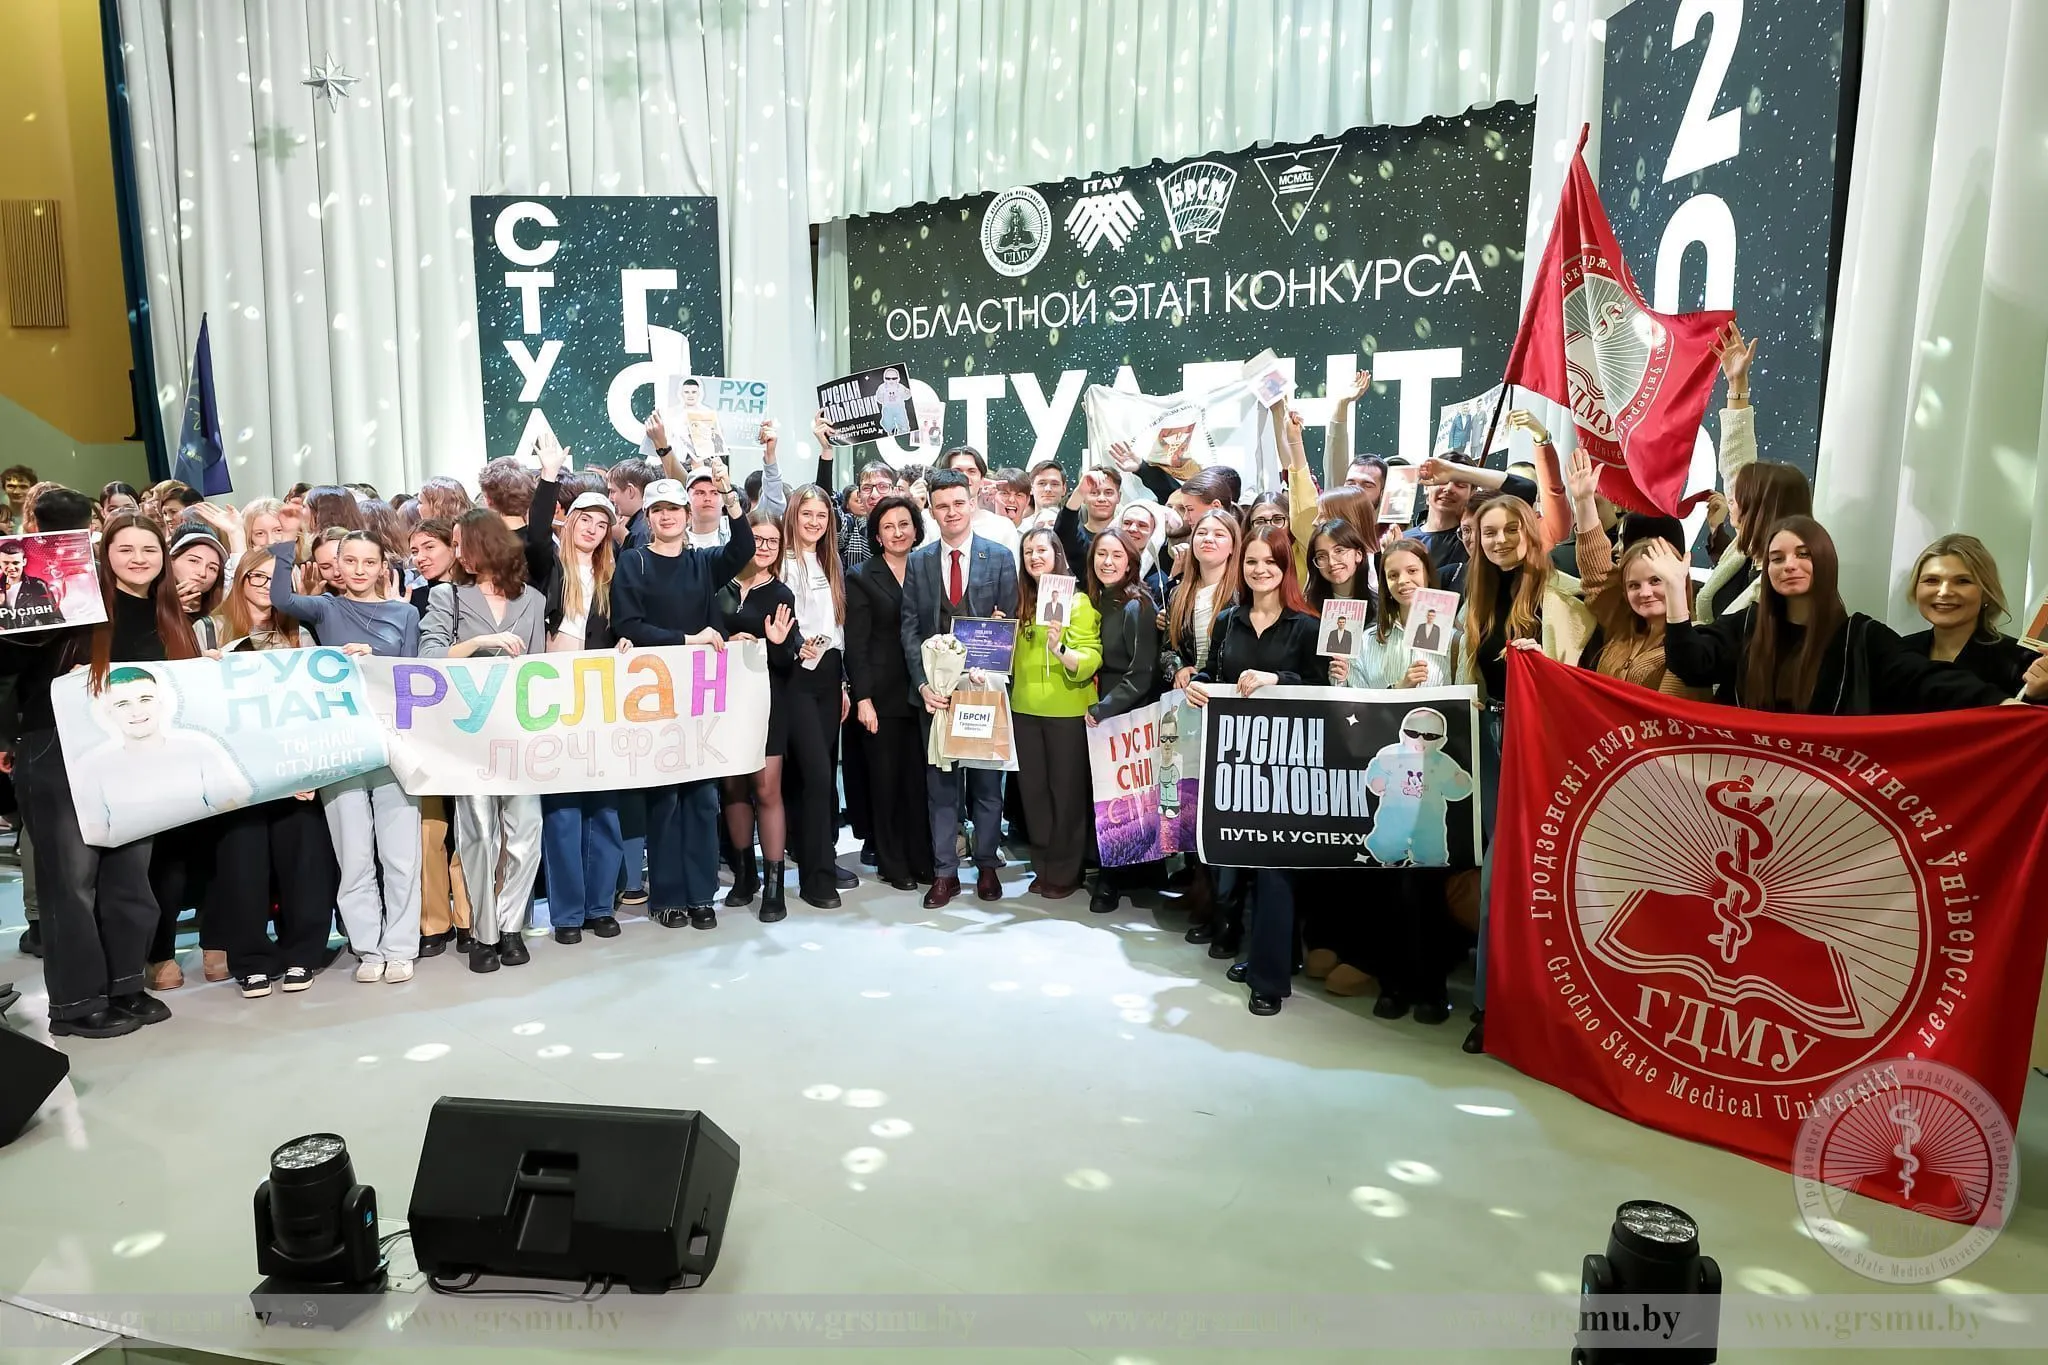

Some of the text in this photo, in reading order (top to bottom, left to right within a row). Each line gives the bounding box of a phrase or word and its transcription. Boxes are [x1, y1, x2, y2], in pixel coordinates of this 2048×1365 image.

[1170, 176, 1228, 208] БРСМ
[1279, 171, 1315, 186] MCMXL
[886, 250, 1483, 341] ОБЛАСТНОЙ ЭТАП КОНКУРСА
[719, 380, 766, 398] РУС
[820, 380, 862, 408] РУСЛАН
[718, 397, 764, 414] ЛАН
[1567, 379, 1615, 436] ДМУ
[860, 427, 878, 436] ГОДА
[0, 604, 53, 620] Руслан
[220, 648, 350, 690] РУС
[225, 690, 359, 735] ЛАН
[962, 712, 987, 721] БРСМ
[1217, 714, 1325, 768] РУСЛАН
[275, 747, 367, 777] СТУДЕНТ
[1214, 762, 1370, 818] ОЛЬХОВИК
[1220, 827, 1368, 846] ПУТЬ К УСПЕХУ
[1530, 759, 1591, 920] Гродзенскі
[1751, 733, 1953, 843] медыцынскі
[1917, 850, 1980, 1049] ўніверсітэт
[1546, 955, 1601, 1032] Grodno
[1599, 1029, 1658, 1083] State
[1665, 1070, 1764, 1119] Medical
[1773, 1063, 1903, 1122] University
[1633, 983, 1821, 1074] ГДМУ
